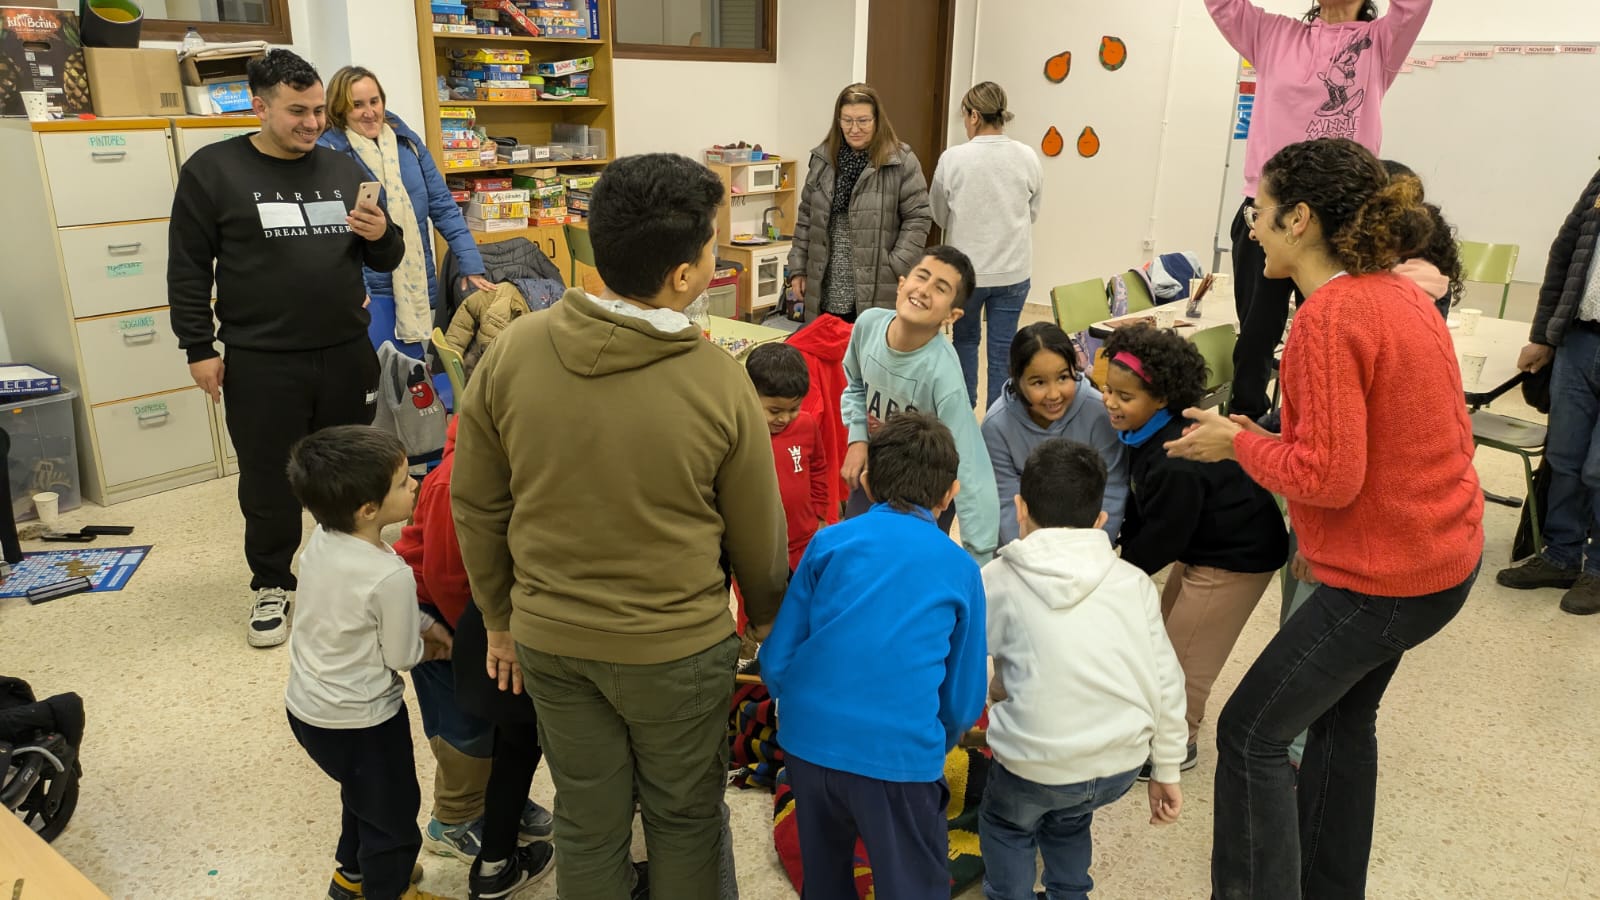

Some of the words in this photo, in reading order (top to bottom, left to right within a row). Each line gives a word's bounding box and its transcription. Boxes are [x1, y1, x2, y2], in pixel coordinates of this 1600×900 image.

[253, 190, 342, 200] PARIS
[264, 228, 308, 238] DREAM
[312, 225, 353, 235] MAKER
